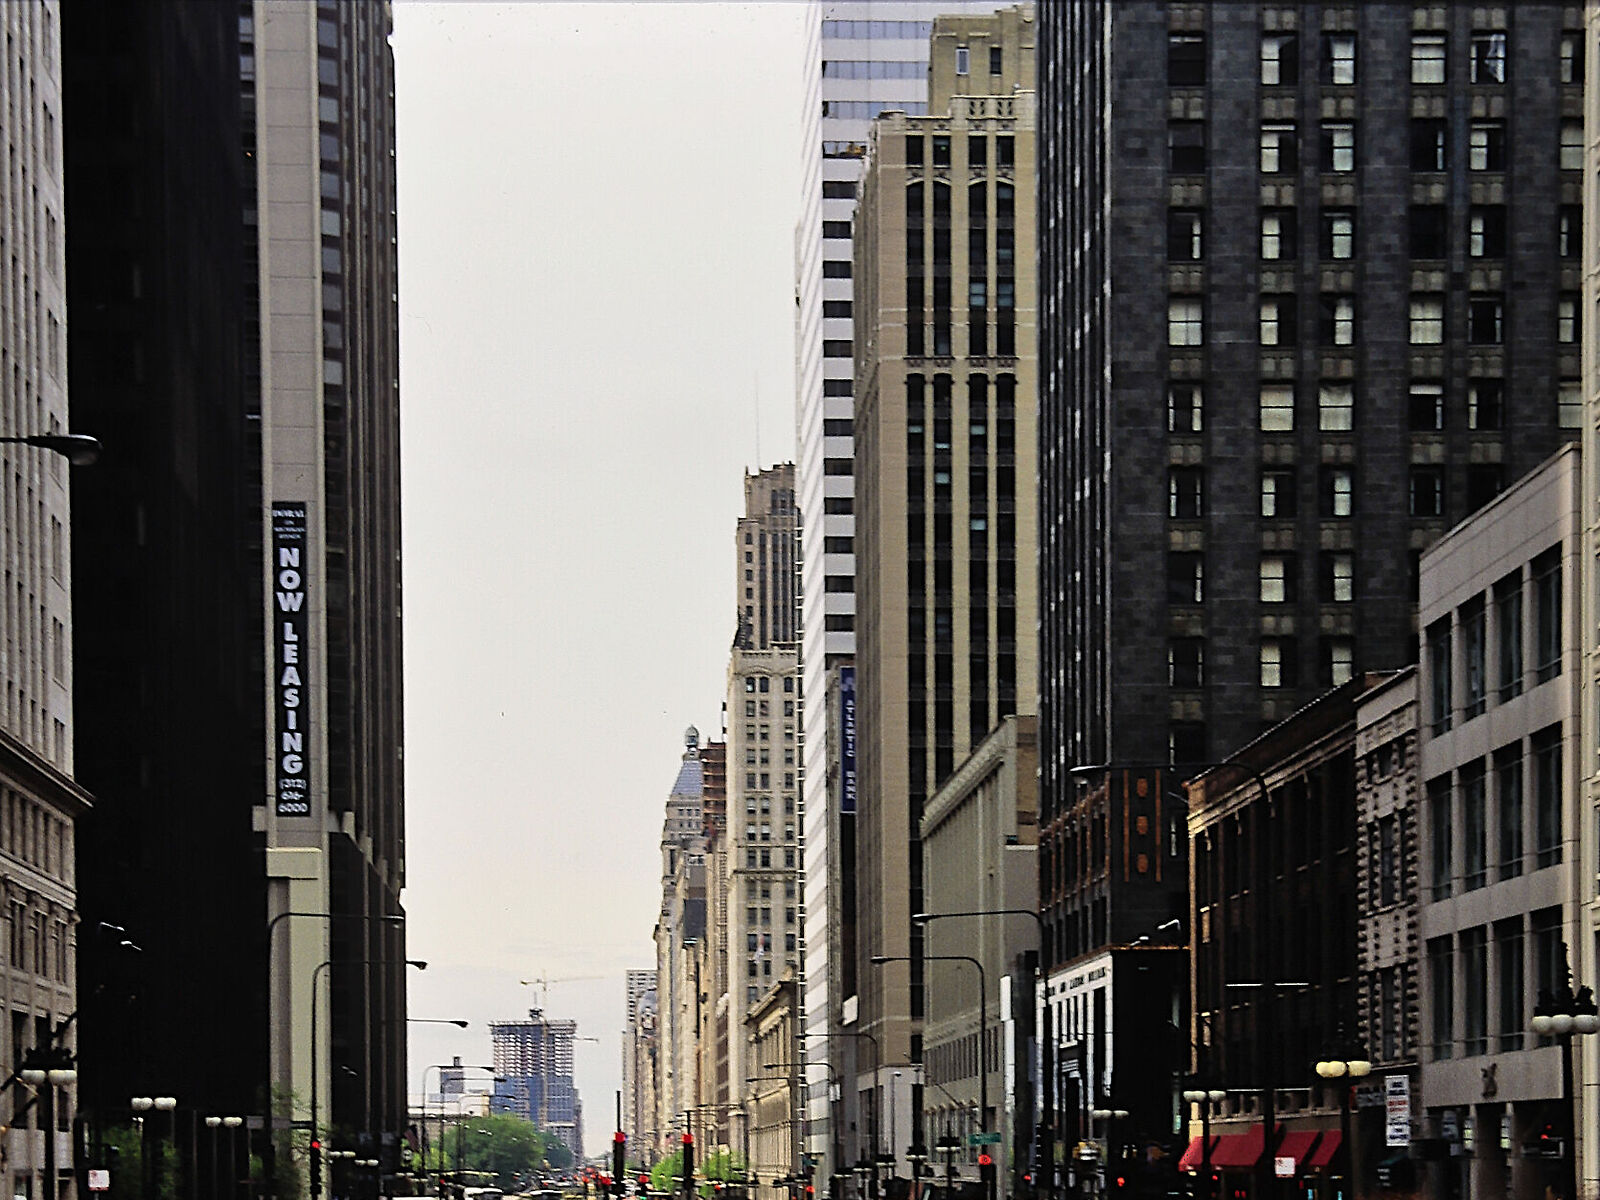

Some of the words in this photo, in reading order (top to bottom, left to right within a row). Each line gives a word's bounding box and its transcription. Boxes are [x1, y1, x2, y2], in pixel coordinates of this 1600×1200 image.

[275, 547, 305, 612] NOW
[281, 622, 304, 774] LEASING
[845, 699, 856, 757] ATLANTIC
[278, 802, 308, 813] 6000
[845, 771, 856, 800] BANK
